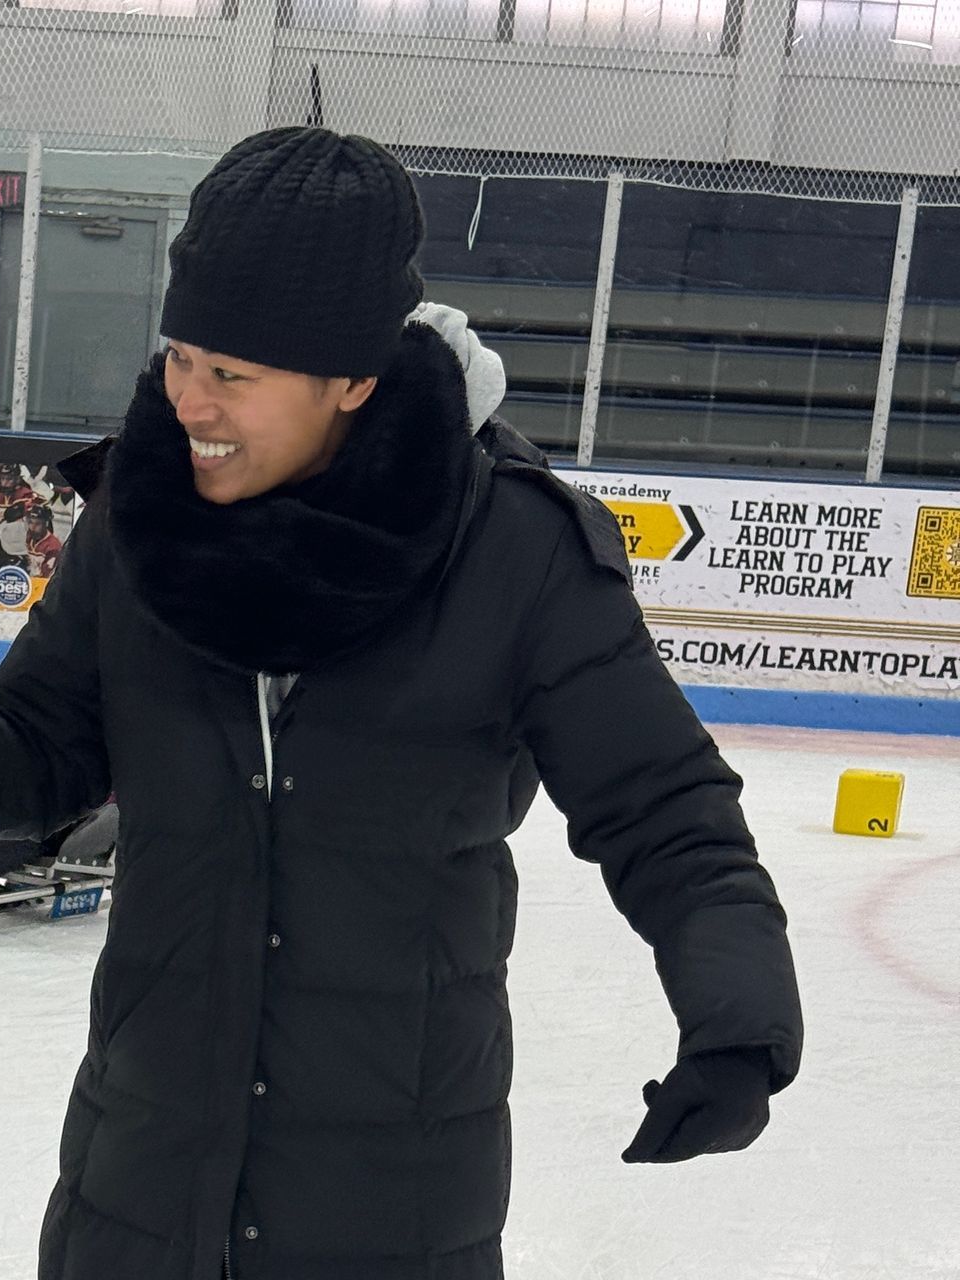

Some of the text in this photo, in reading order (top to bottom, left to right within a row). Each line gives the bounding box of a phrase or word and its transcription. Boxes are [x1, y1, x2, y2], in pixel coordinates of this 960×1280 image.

[600, 483, 672, 502] academy
[730, 500, 883, 530] LEARN MORE
[735, 525, 871, 553] ABOUT THE
[707, 547, 893, 578] LEARN TO PLAY
[739, 573, 854, 600] PROGRAM
[867, 818, 889, 832] 2
